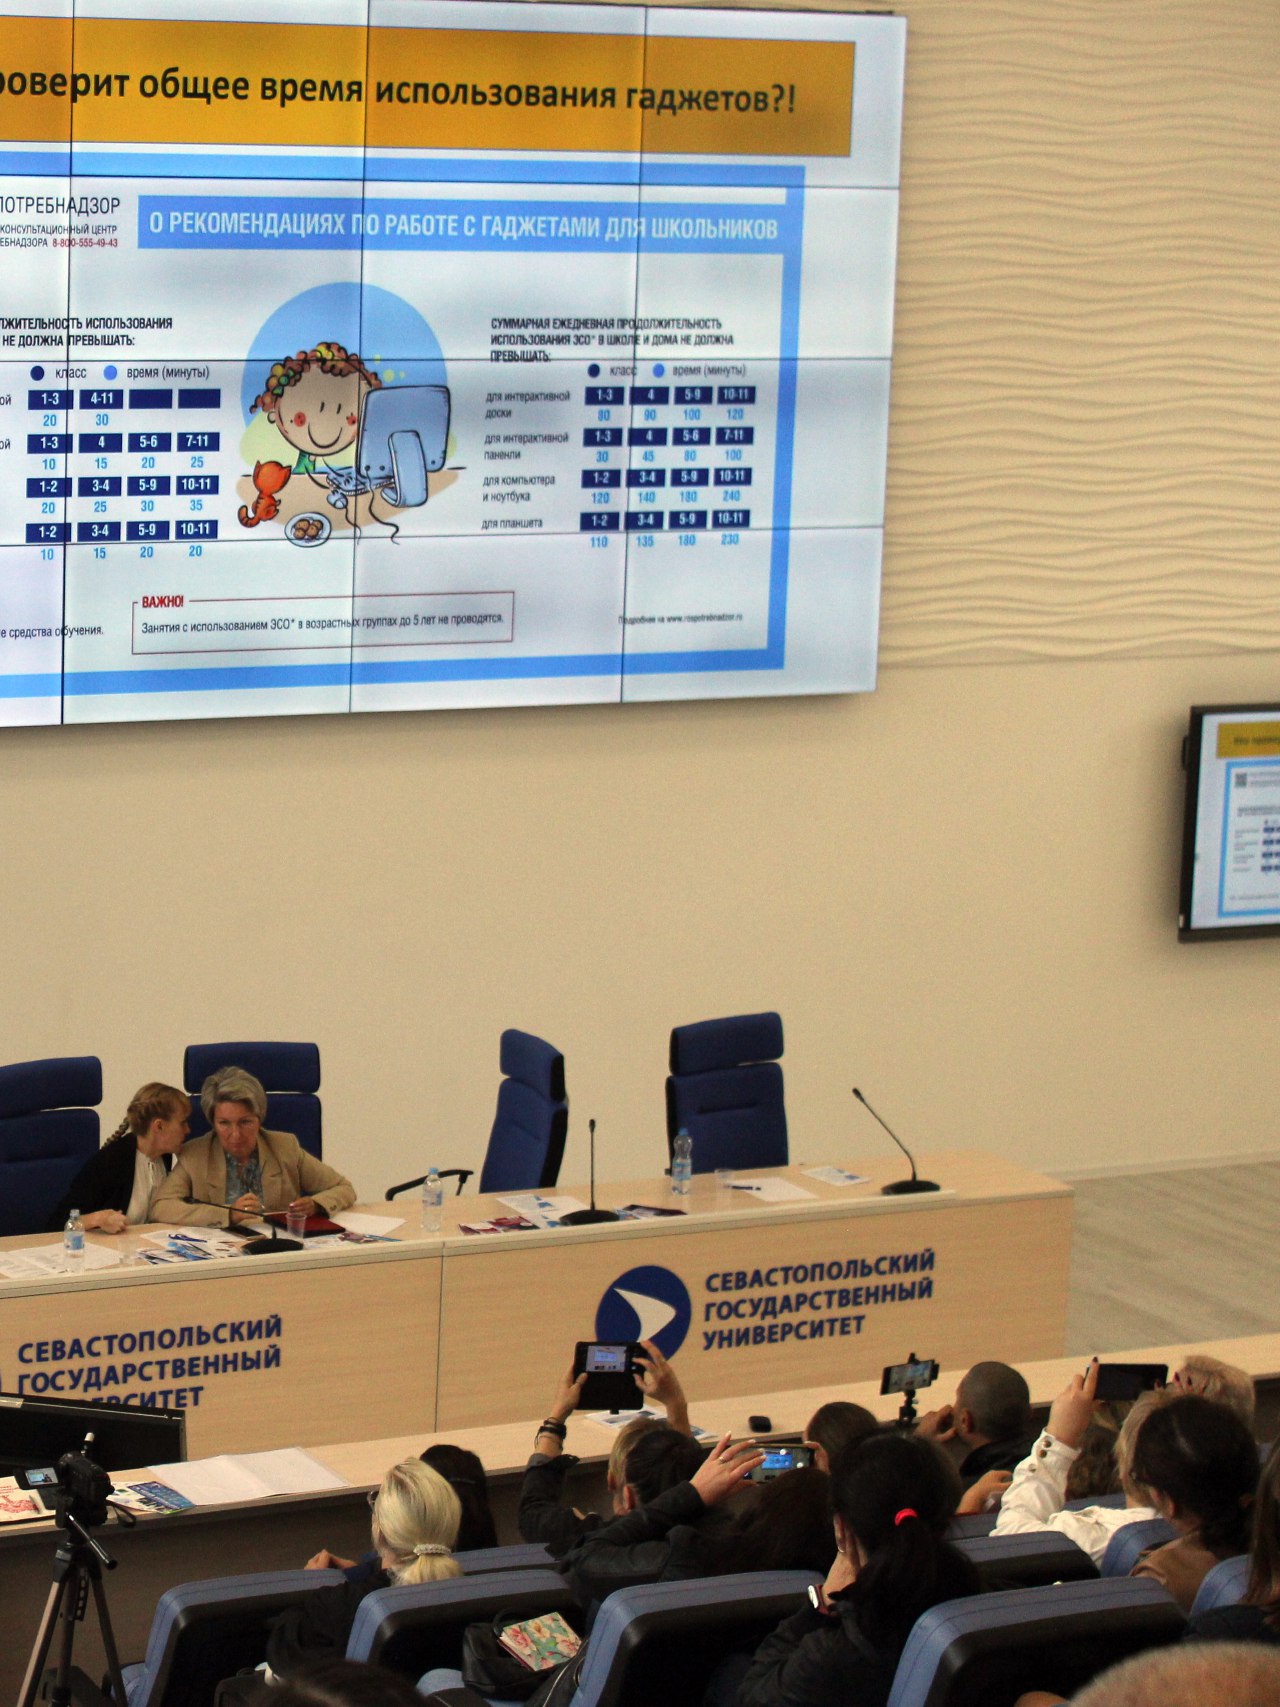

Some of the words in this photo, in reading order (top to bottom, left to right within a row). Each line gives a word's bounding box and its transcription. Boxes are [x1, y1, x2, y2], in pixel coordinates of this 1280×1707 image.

[140, 66, 249, 104] общее
[261, 77, 362, 107] время
[375, 79, 616, 109] использования
[627, 84, 796, 115] гаджетов?!
[0, 224, 89, 236] КОНСУЛЬТАЦИОННЫЙ
[91, 225, 118, 236] ЦЕНТР
[150, 212, 163, 234] О
[169, 212, 346, 238] РЕКОМЕНДАЦИЯХ
[352, 214, 379, 236] ПО
[385, 214, 459, 236] РАБОТЕ
[464, 215, 476, 236] С
[481, 215, 600, 240] ГАДЖЕТАМИ
[605, 217, 645, 241] ДЛЯ
[652, 218, 778, 239] ШКОЛЬНИКОВ
[52, 238, 118, 248] 8-800-555-49-43
[85, 318, 173, 330] ИСПОЛЬЗОВАНИЯ
[491, 318, 550, 330] СУММАРНАЯ
[552, 318, 615, 331] ЕЖЕДНЕВНАЯ
[617, 318, 722, 331] ПРОДОЛЖИТЕЛЬНОСТЬ
[2, 335, 16, 347] НЕ
[18, 335, 63, 348] ДОЛЖНА
[68, 334, 135, 347] ПРЕВЫШАТЬ:
[490, 334, 571, 346] ИСПОЛЬЗОВАНИЯ
[598, 335, 604, 346] В
[606, 335, 641, 346] ШКОЛЕ
[643, 335, 650, 346] И
[652, 335, 679, 347] ДОМА
[681, 335, 692, 346] НЕ
[694, 335, 735, 347] ДОЛЖНА
[490, 350, 552, 363] ПРЕВЫШАТЬ:
[56, 368, 87, 379] класс
[127, 368, 159, 379] время
[161, 365, 210, 381] (минуты)
[609, 365, 637, 376] класс
[672, 366, 702, 377] время
[704, 364, 747, 378] (минуты)
[41, 392, 59, 405] 1-3
[90, 391, 114, 404] 4-11
[486, 391, 503, 402] для
[505, 390, 570, 403] интерактивной
[596, 389, 613, 400] 1-3
[647, 389, 654, 400] 4
[723, 388, 749, 400] 10-11
[43, 414, 57, 427] 20
[95, 414, 109, 426] 30
[485, 409, 512, 420] доски
[40, 436, 58, 449] 1-3
[98, 436, 105, 448] 4
[140, 435, 158, 447] 5-6
[186, 435, 209, 447] 7-11
[484, 432, 502, 444] для
[504, 431, 569, 444] интерактивной
[595, 430, 611, 442] 1-3
[646, 430, 653, 441] 4
[724, 429, 744, 441] 7-11
[484, 449, 521, 460] паненли
[42, 458, 56, 470] 10
[95, 457, 108, 469] 15
[141, 457, 155, 469] 20
[190, 456, 204, 468] 25
[483, 475, 500, 486] для
[501, 474, 556, 486] компьютера
[593, 472, 610, 483] 1-2
[639, 471, 656, 483] 3-4
[719, 469, 745, 481] 10-11
[39, 480, 58, 493] 1-2
[92, 479, 109, 492] 3-4
[139, 478, 157, 491] 5-9
[181, 478, 211, 491] 10-11
[482, 492, 489, 501] и
[490, 489, 531, 503] ноутбука
[41, 502, 56, 515] 20
[93, 501, 107, 513] 25
[140, 500, 154, 512] 30
[189, 499, 203, 511] 35
[38, 525, 57, 538] 1-2
[91, 524, 109, 537] 3-4
[138, 523, 156, 536] 5-9
[180, 522, 210, 535] 10-11
[481, 518, 498, 530] для
[499, 517, 543, 529] планшета
[41, 549, 54, 561] 10
[93, 547, 107, 559] 15
[140, 546, 154, 558] 20
[189, 545, 203, 557] 20
[141, 595, 184, 608] ВАЖНО!
[142, 622, 180, 634] Занятия
[182, 624, 188, 633] с
[190, 621, 268, 634] использованием
[298, 620, 303, 629] в
[305, 618, 360, 631] возрастных
[362, 617, 398, 629] группах
[399, 617, 411, 627] до
[413, 614, 419, 626] 5
[421, 616, 436, 626] лет
[438, 616, 448, 625] не
[450, 613, 504, 627] проводятся.
[9, 627, 52, 641] средства
[55, 626, 104, 640] обучения.
[705, 1248, 935, 1293] СЕВАСТОПОЛЬСКИЙ
[704, 1279, 934, 1323] ГОСУДАРСТВЕННЫЙ
[18, 1315, 283, 1364] СЕВАСТОПОЛЬСКИЙ
[703, 1314, 866, 1351] УНИВЕРСИТЕТ
[19, 1345, 282, 1396] ГОСУДАРСТВЕННЫЙ
